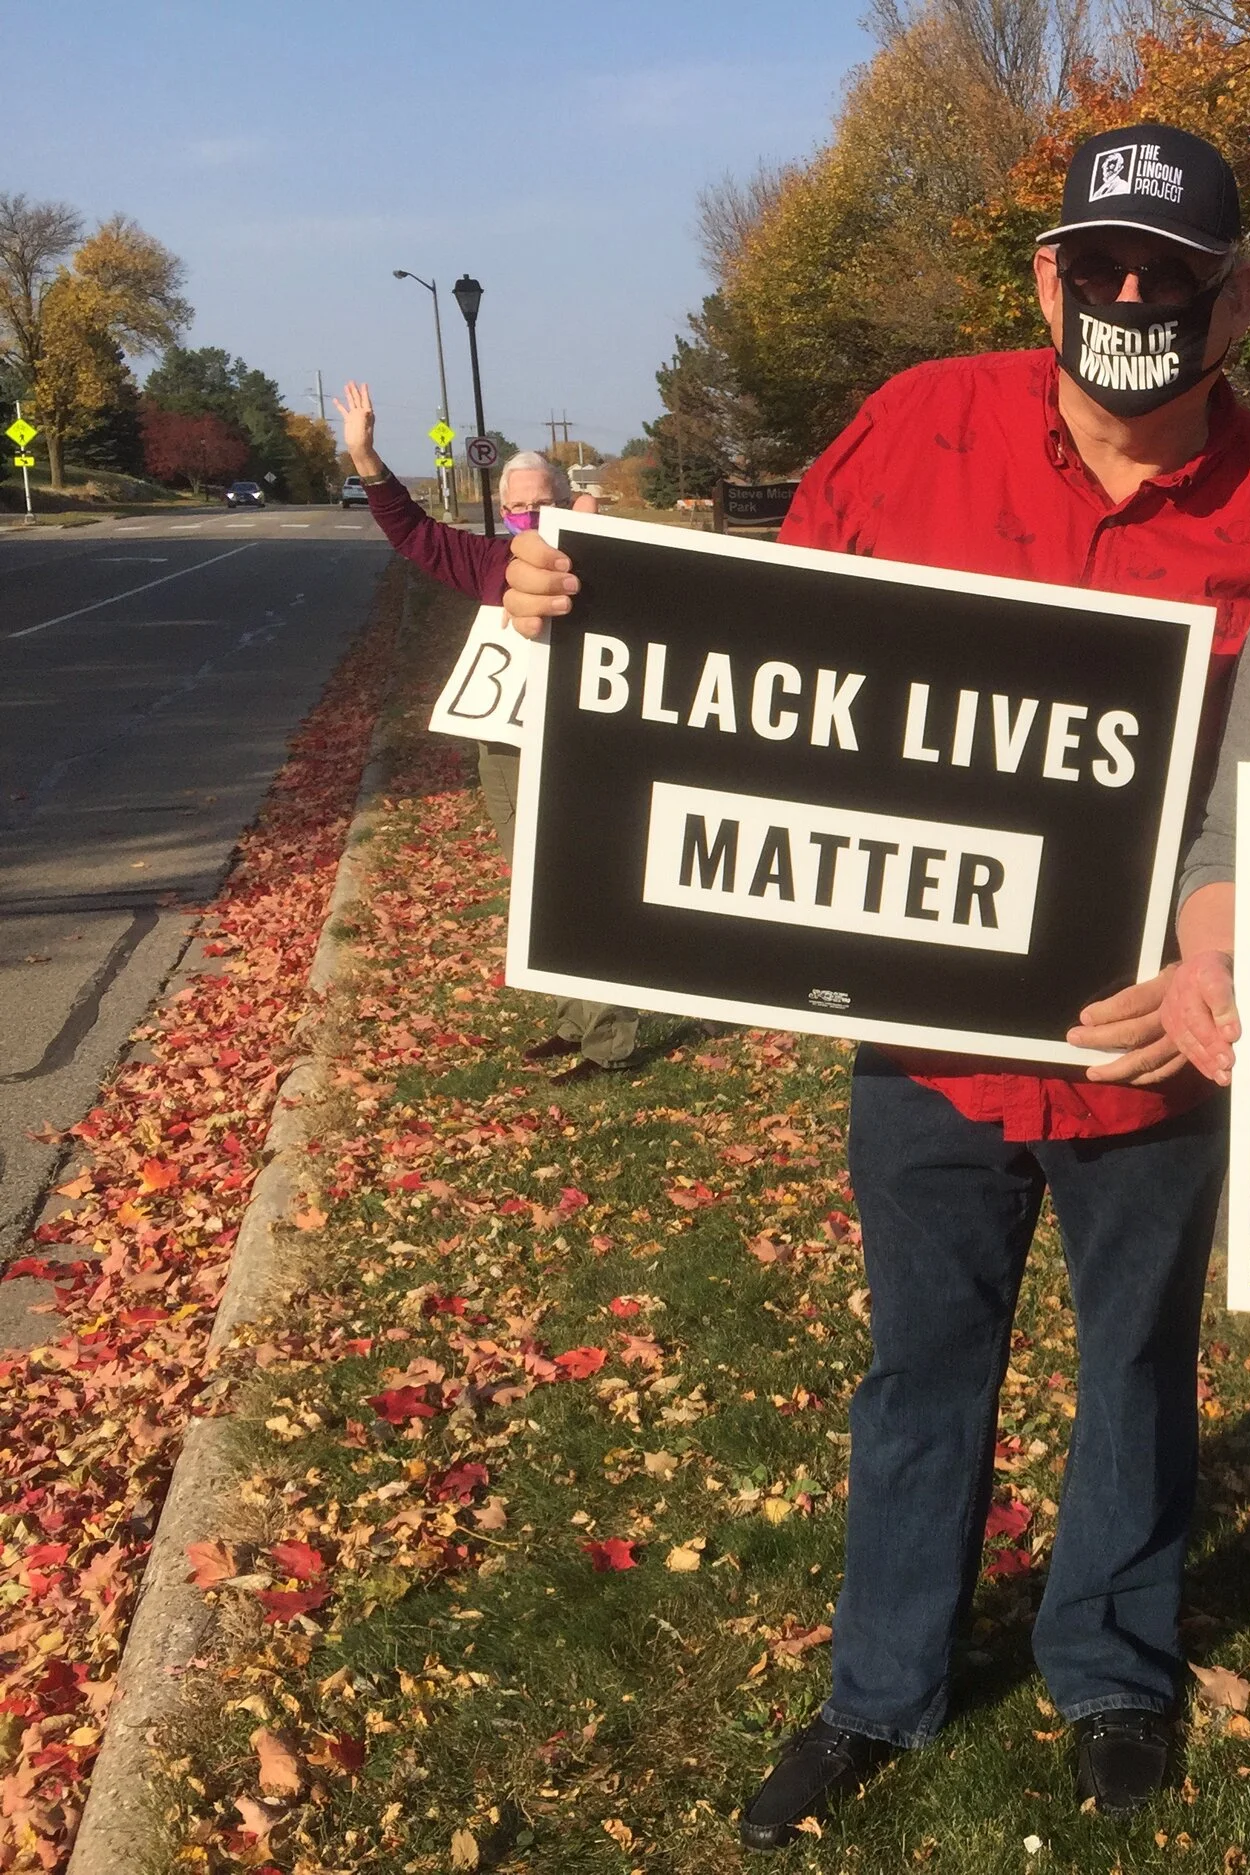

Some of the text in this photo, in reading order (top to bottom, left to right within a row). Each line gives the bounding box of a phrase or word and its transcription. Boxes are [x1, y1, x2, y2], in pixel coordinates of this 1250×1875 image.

[1140, 144, 1161, 160] THE
[1136, 160, 1183, 186] LINCOLN
[1133, 178, 1184, 204] PROJECT
[1079, 312, 1179, 356] TIRED OF
[1079, 344, 1180, 391] WINNING
[728, 488, 763, 499] Steve
[729, 501, 757, 513] Park
[578, 632, 1140, 788] BLACK LIVES
[678, 813, 1006, 930] MATTER
